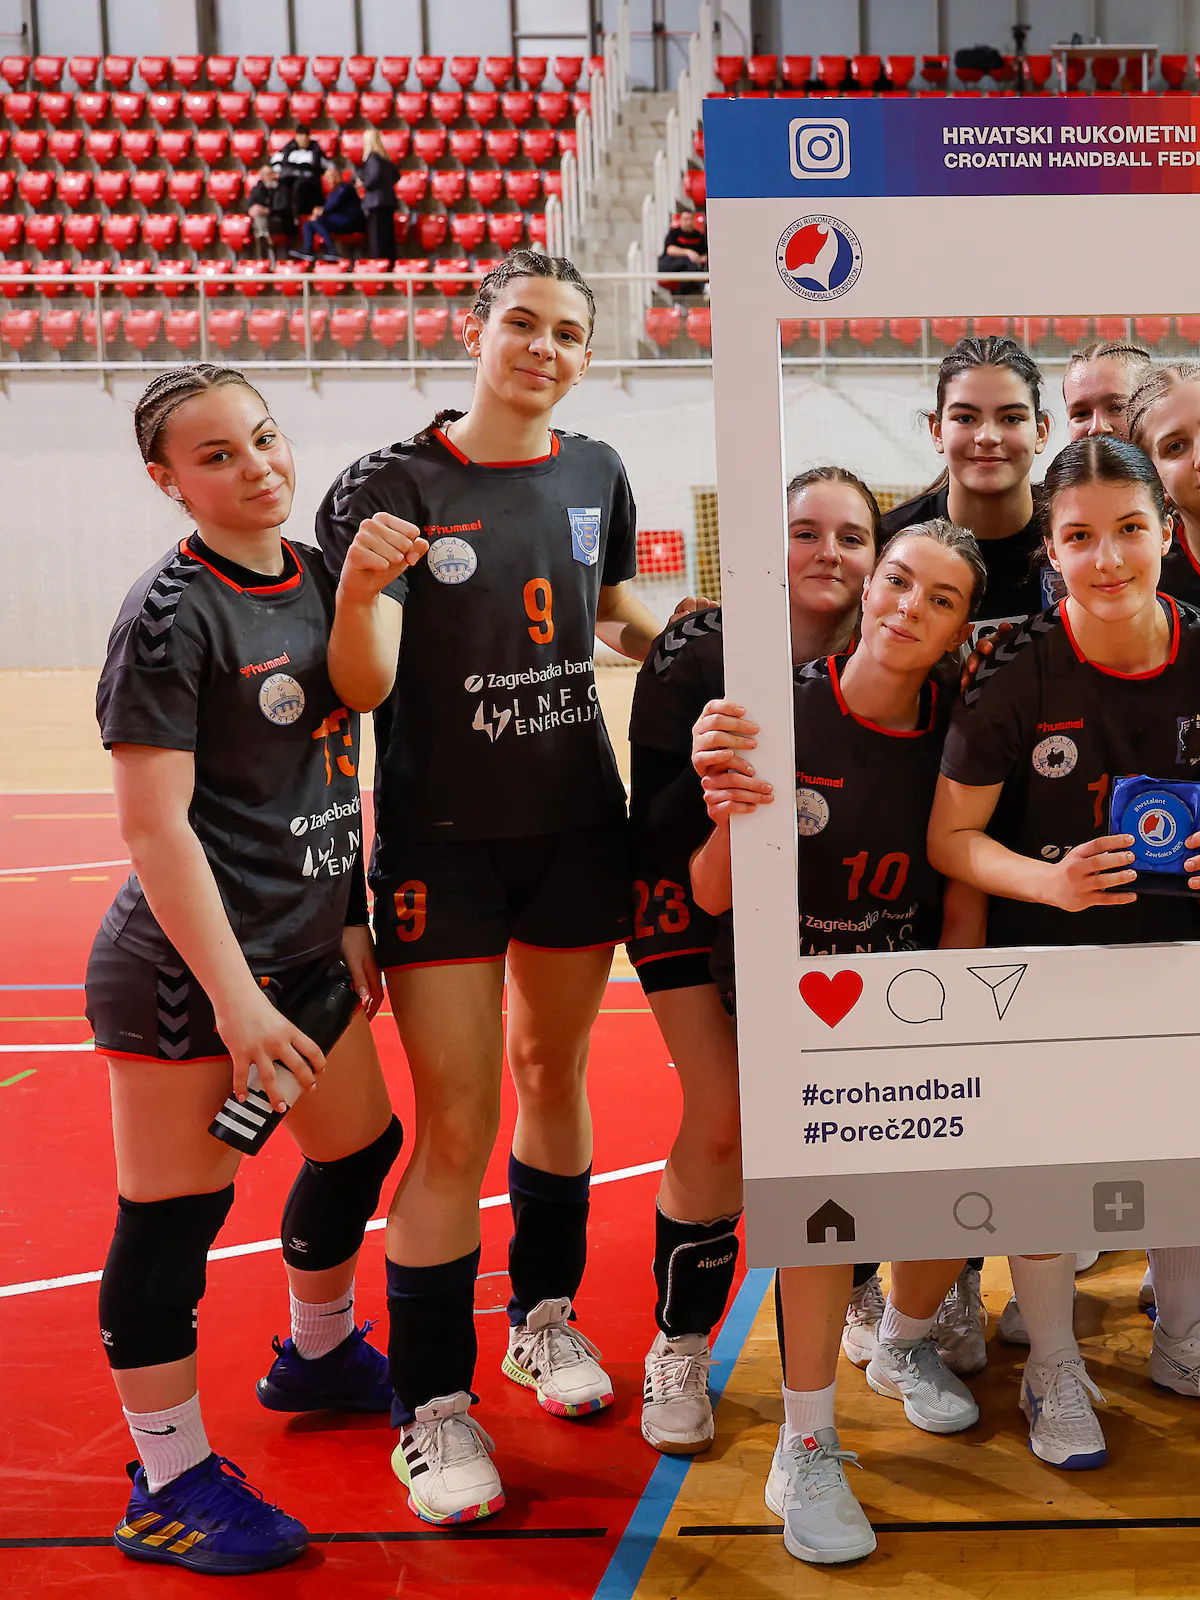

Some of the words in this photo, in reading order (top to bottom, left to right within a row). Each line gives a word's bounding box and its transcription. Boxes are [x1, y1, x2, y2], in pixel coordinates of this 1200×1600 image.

[942, 126, 1052, 145] HRVATSKI
[1060, 125, 1197, 144] RUKOMETNI
[943, 151, 1043, 168] CROATIAN
[1049, 151, 1152, 168] HANDBALL
[780, 221, 804, 248] HRVATSKI
[803, 216, 842, 230] RUKOMETNI
[841, 227, 858, 248] SAVEZ
[780, 267, 802, 293] CROATIAN
[801, 289, 833, 300] HANDBALL
[832, 266, 860, 297] FEDERATION
[436, 519, 483, 535] hummel
[431, 538, 469, 553] GRAD
[522, 577, 555, 645] 9
[250, 652, 291, 675] hummel
[487, 662, 562, 690] Zagrebačka
[564, 655, 594, 675] bank
[262, 676, 294, 693] GRAD
[1043, 717, 1084, 733] hummel
[311, 706, 356, 787] 13
[1039, 737, 1073, 749] GRAD
[800, 771, 844, 789] hummel
[799, 790, 824, 805] RAD
[1133, 797, 1167, 813] #hrstalent
[1172, 840, 1184, 852] 2025
[842, 850, 910, 901] 10
[394, 880, 428, 943] 9
[632, 878, 691, 939] 23
[805, 910, 880, 933] Zagrebačka
[802, 1076, 981, 1106] #crohandball
[803, 1116, 964, 1145] #Poreč2025
